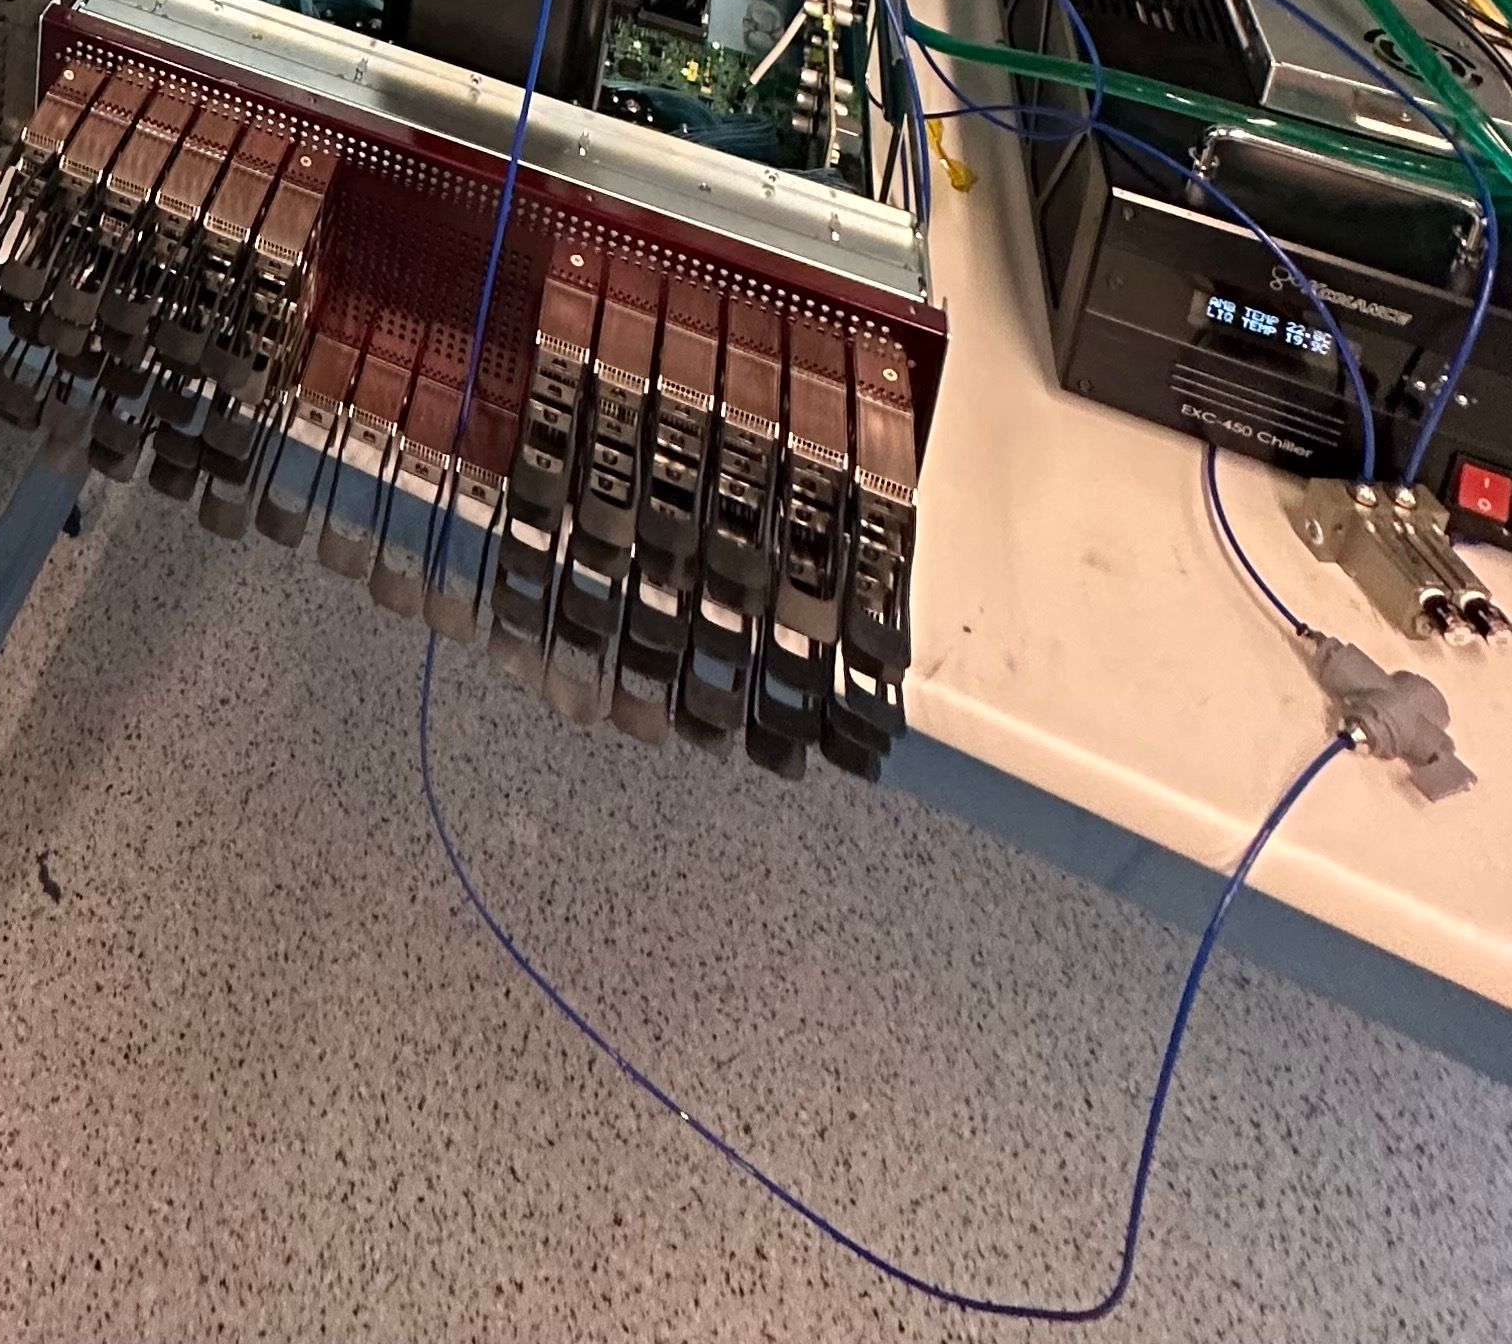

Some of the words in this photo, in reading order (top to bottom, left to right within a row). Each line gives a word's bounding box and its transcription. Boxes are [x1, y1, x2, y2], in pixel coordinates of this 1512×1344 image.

[1206, 306, 1235, 325] LIQ
[1241, 315, 1278, 337] TEMP
[1208, 295, 1237, 313] AMB
[1244, 305, 1280, 325] TEMP
[1180, 402, 1254, 439] EXC-450
[1256, 429, 1315, 460] Chiller
